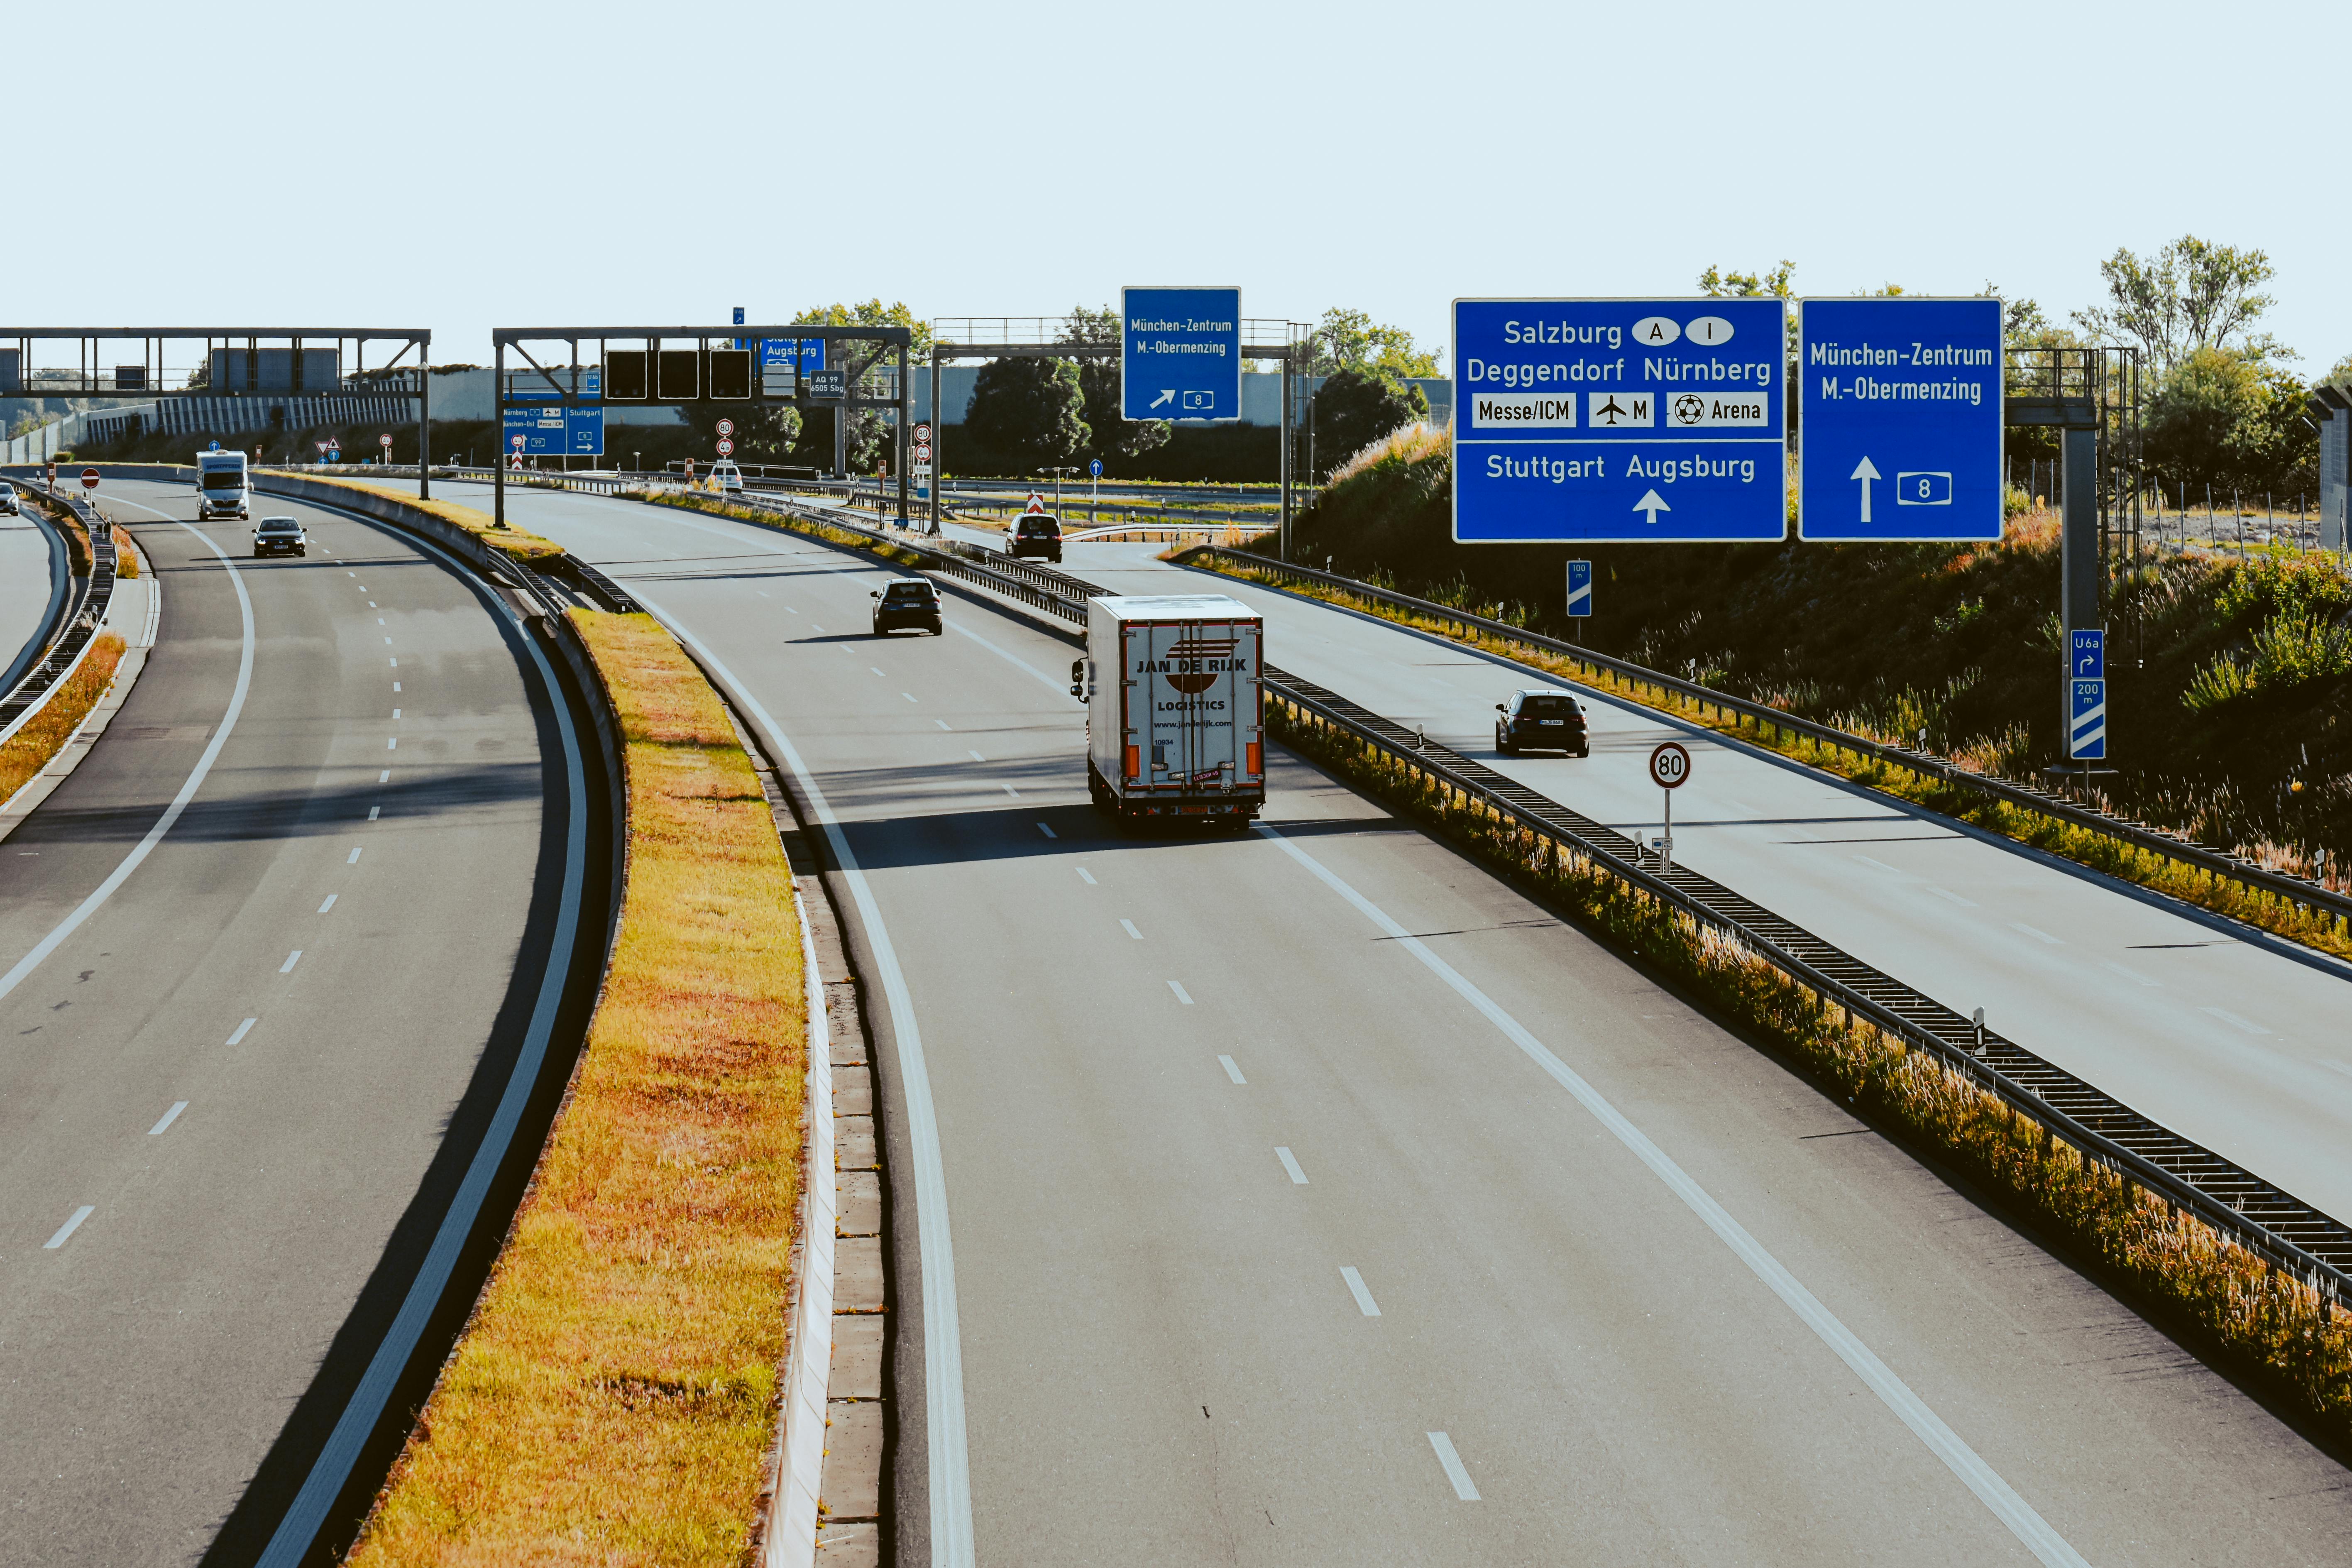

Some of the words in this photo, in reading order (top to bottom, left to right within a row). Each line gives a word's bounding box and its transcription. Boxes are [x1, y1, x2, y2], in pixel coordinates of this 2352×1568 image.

[1131, 318, 1231, 331] München-Zentrum
[1504, 320, 1621, 349] Salzburg
[1649, 323, 1663, 340] A
[1708, 323, 1711, 339] I
[767, 346, 816, 357] Augsburg
[1137, 340, 1225, 357] M.-Obermenzing
[1811, 342, 1992, 365] München-Zentrum
[1468, 358, 1624, 387] Deggendorf
[1645, 357, 1770, 386] Nürnberg
[811, 384, 829, 392] 6505
[829, 384, 843, 393] Sbg
[1822, 377, 1981, 406] M.-Obermenzing
[1195, 394, 1202, 405] 8
[570, 409, 600, 418] Stuttgart
[1479, 400, 1569, 420] Messe/ICM
[1634, 400, 1646, 419] M
[1712, 400, 1760, 419] Arena
[1487, 455, 1604, 484] Stuttgart
[1626, 454, 1754, 483] Augsburg
[1919, 479, 1930, 498] 8
[2076, 638, 2083, 648] U
[2086, 638, 2099, 648] 6a
[1137, 660, 1171, 673] JAN
[1178, 659, 1201, 673] DE
[1208, 658, 1247, 672] RIJK
[2078, 684, 2098, 695] 200
[1158, 701, 1225, 711] LOGISTICS
[1658, 754, 1682, 776] 80
